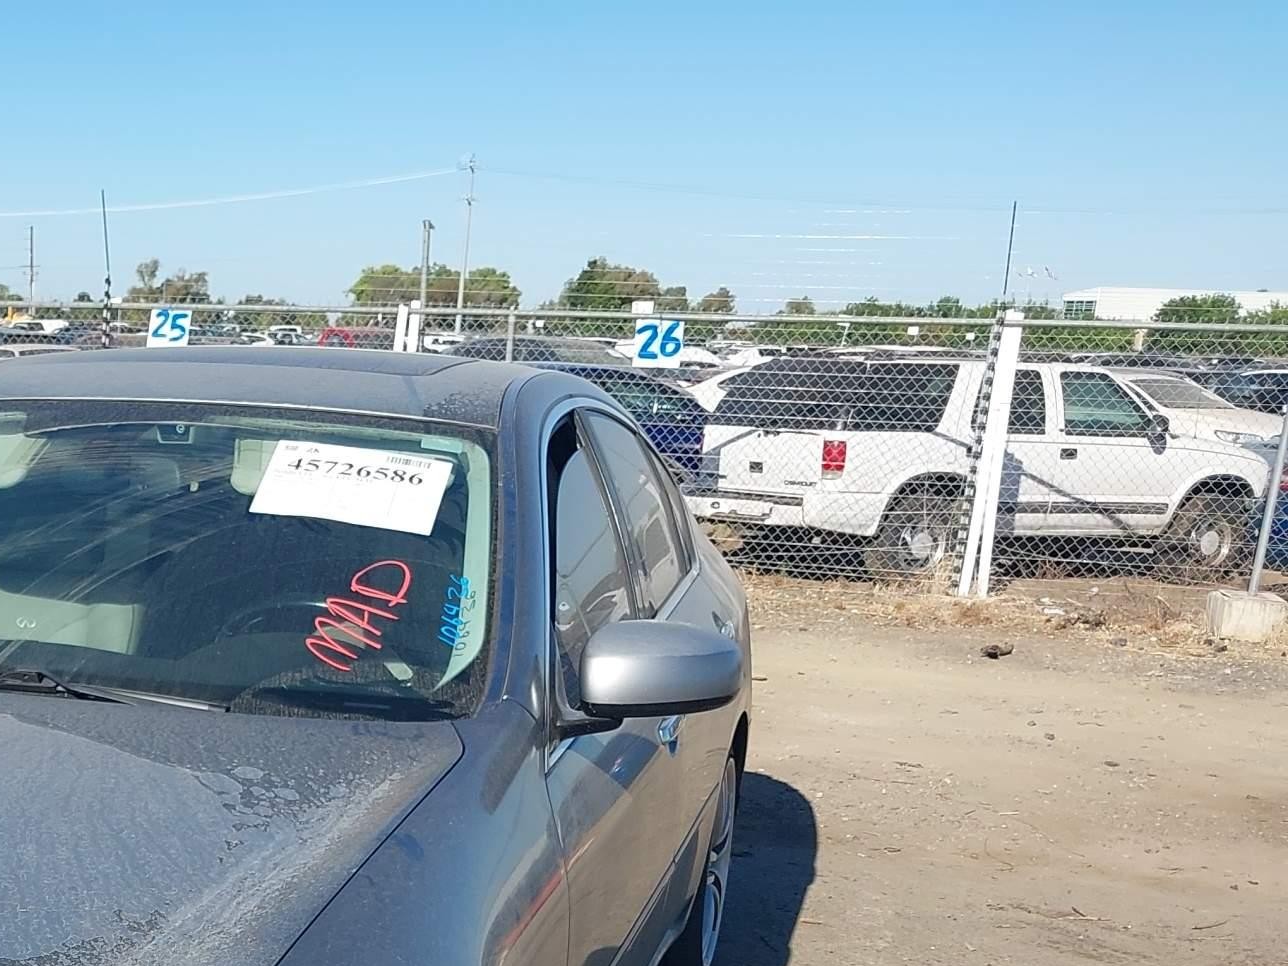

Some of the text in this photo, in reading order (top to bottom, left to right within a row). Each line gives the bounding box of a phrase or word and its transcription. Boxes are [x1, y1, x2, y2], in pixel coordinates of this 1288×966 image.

[151, 309, 189, 342] 25
[636, 320, 681, 360] 26
[287, 457, 424, 486] 45726586
[304, 559, 412, 671] MAD
